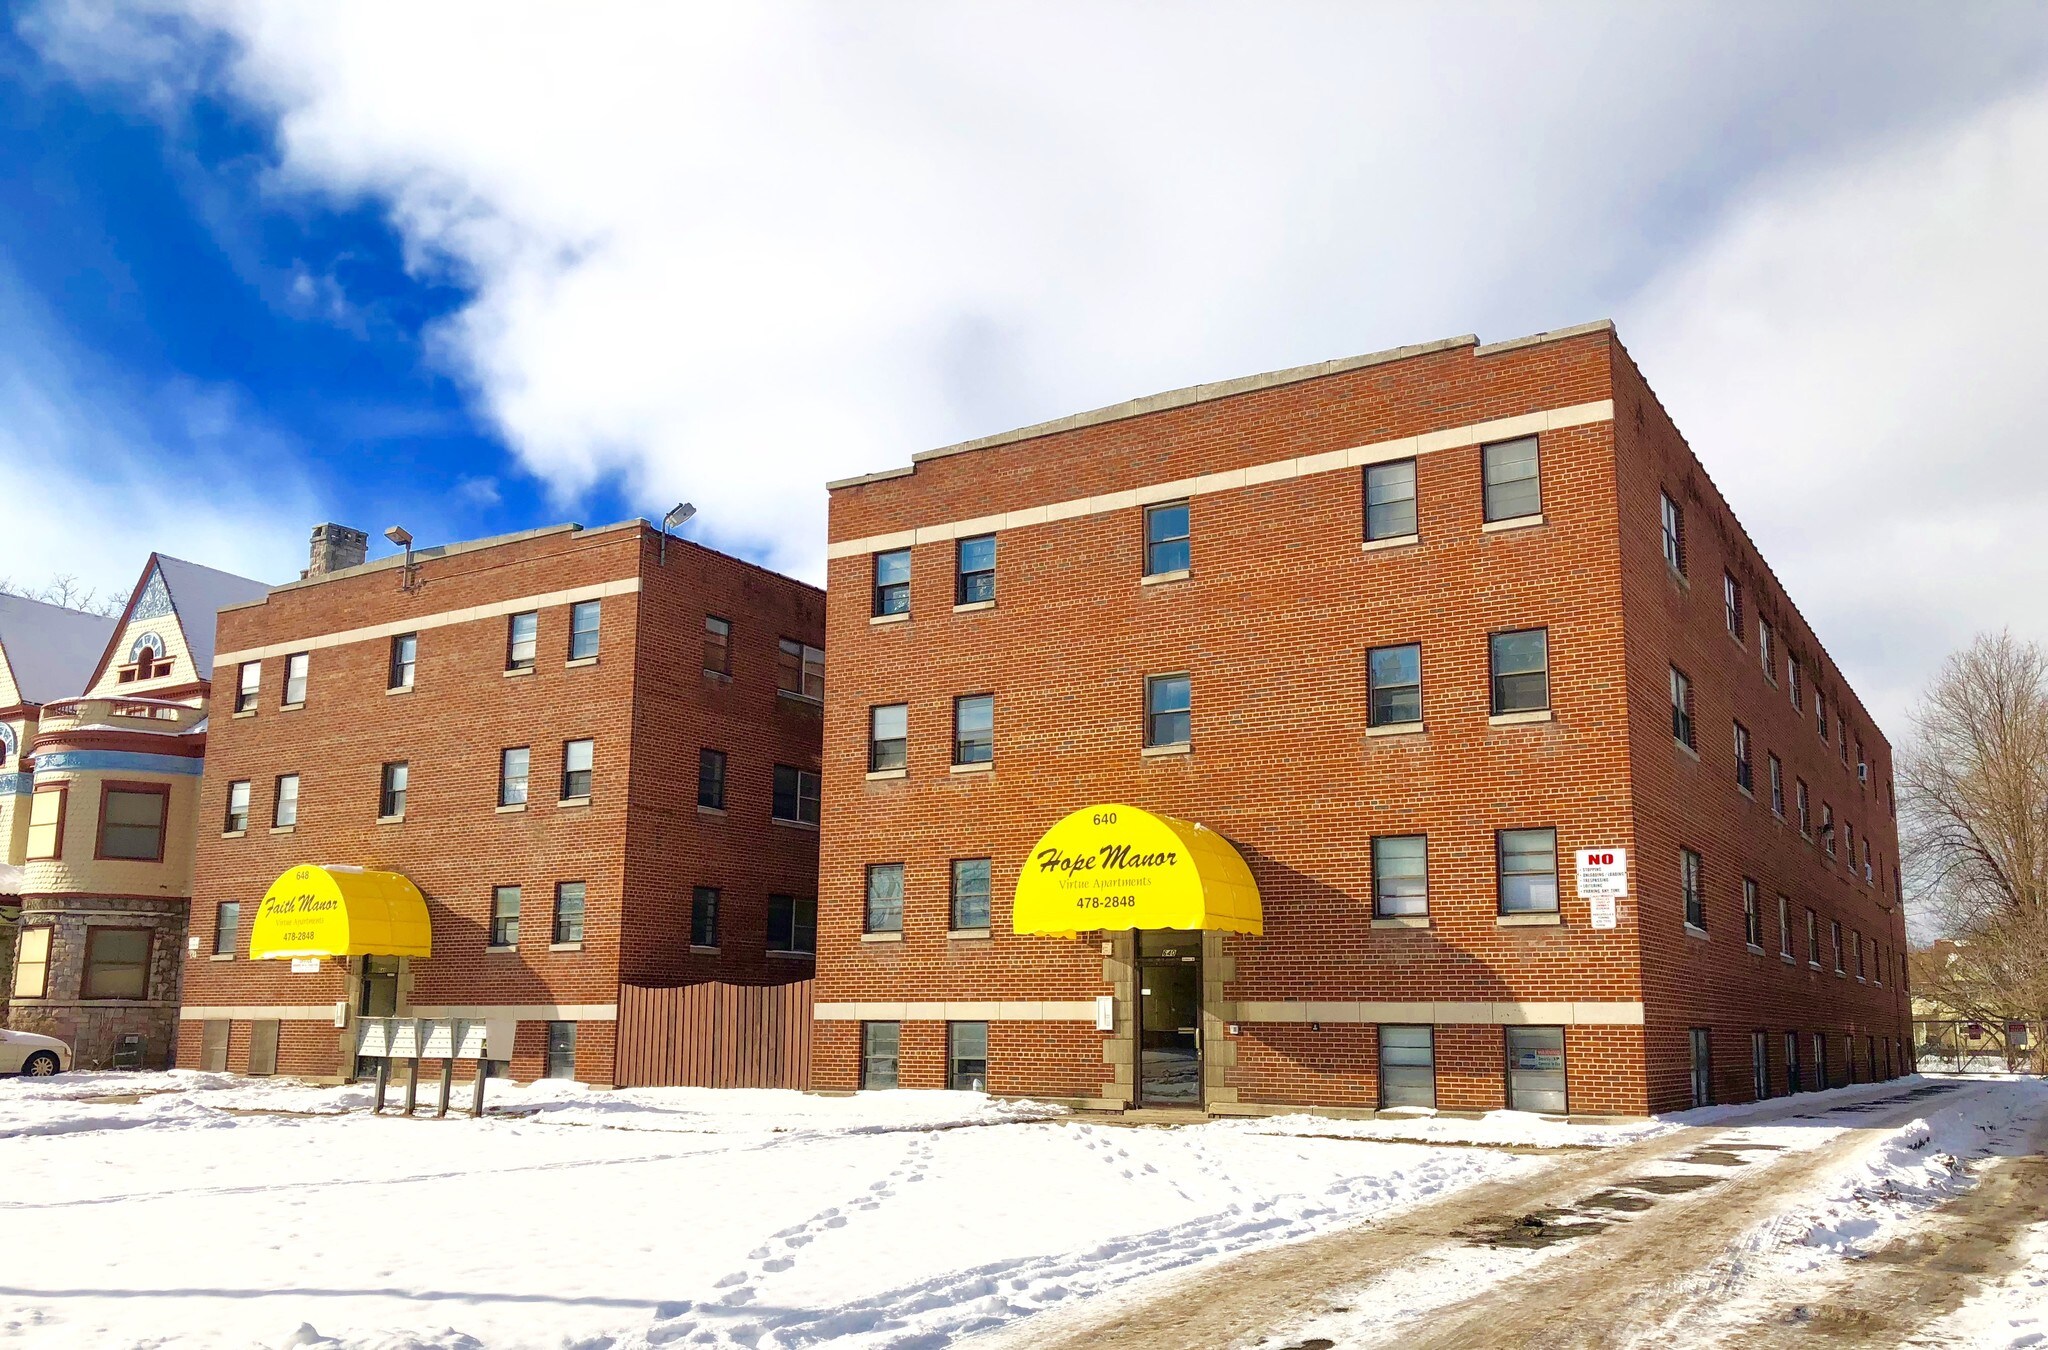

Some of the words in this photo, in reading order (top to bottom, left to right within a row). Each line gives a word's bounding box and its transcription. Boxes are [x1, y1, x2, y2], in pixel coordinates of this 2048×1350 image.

[1093, 812, 1117, 826] 640
[1037, 847, 1096, 877] Hope
[1100, 844, 1177, 870] Manor
[1588, 853, 1614, 865] NO
[296, 870, 310, 880] 648
[1059, 878, 1090, 890] Virtue
[1093, 876, 1152, 891] Apartments
[265, 896, 296, 918] Faith
[298, 894, 338, 912] Manor
[1076, 895, 1136, 909] 478-2848
[283, 931, 315, 941] 478-2848
[1161, 949, 1177, 957] 640
